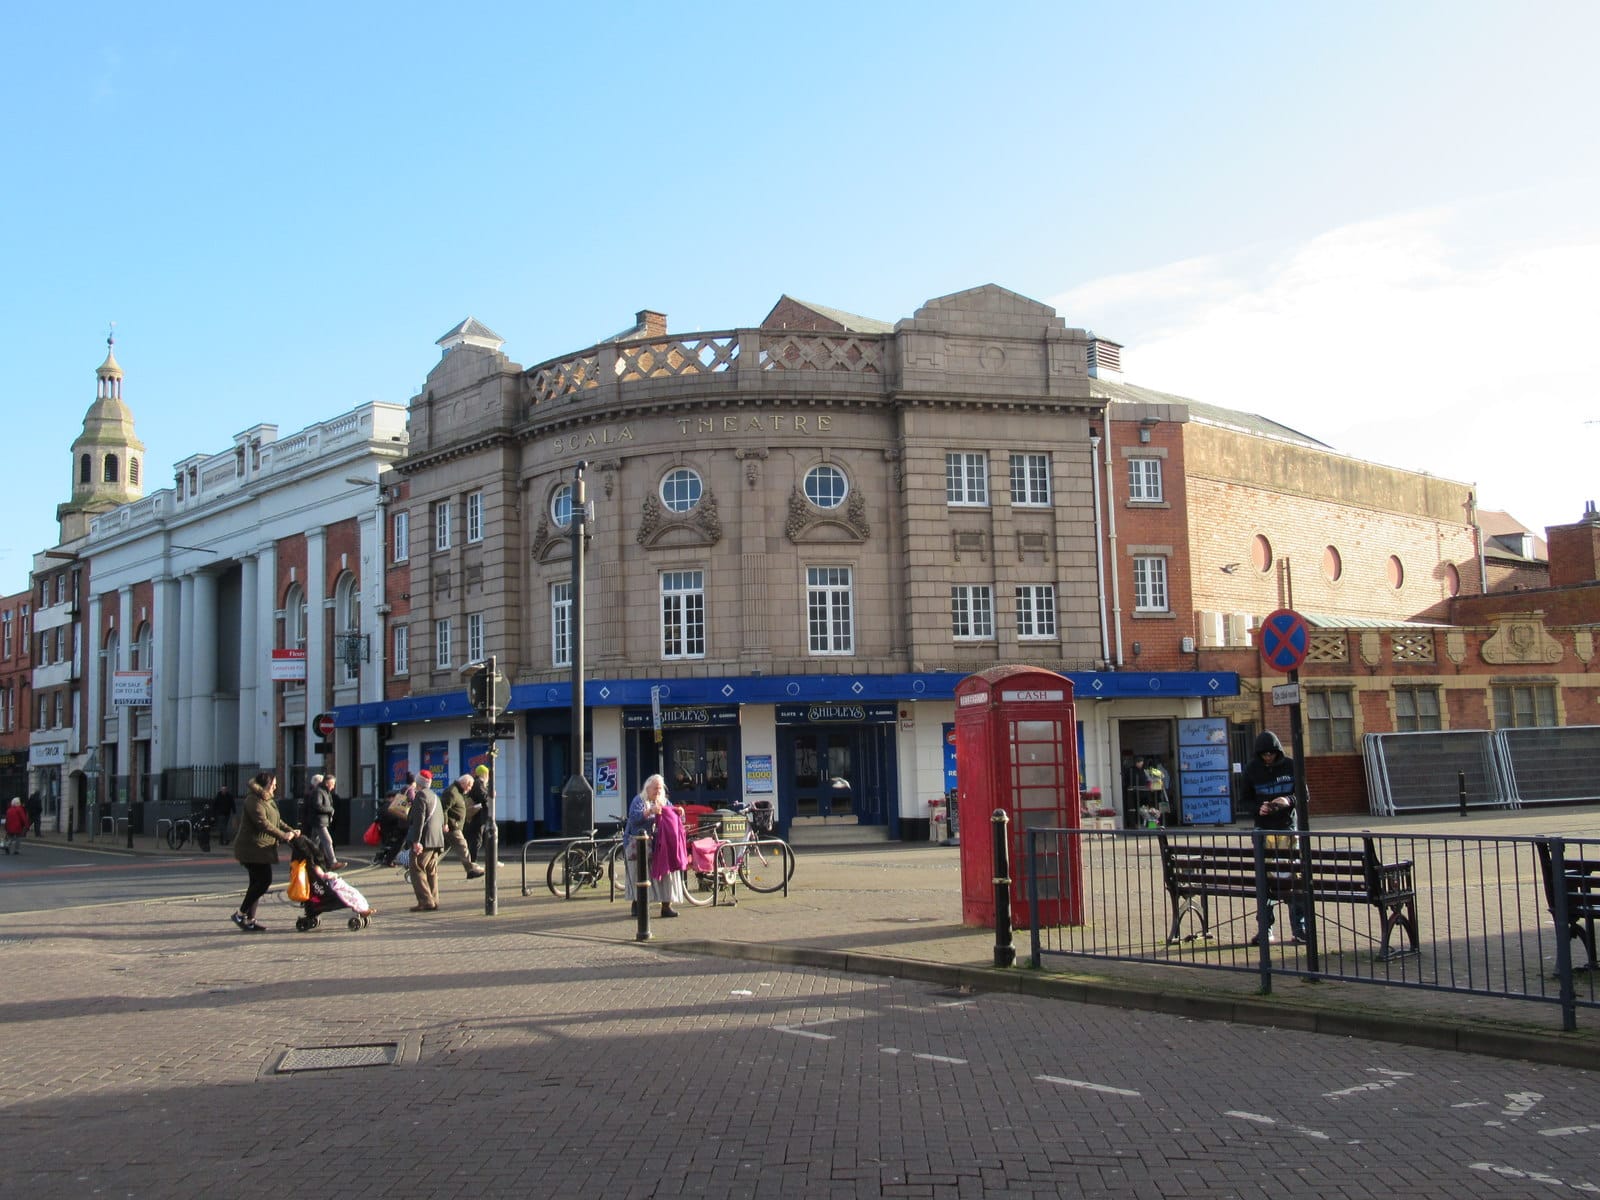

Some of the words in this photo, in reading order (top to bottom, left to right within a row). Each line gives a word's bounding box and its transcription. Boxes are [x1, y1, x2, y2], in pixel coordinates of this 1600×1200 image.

[553, 426, 634, 454] SCALA
[677, 415, 833, 435] THEATRE
[1017, 691, 1048, 700] CASH
[810, 706, 863, 720] SHIPLEYS
